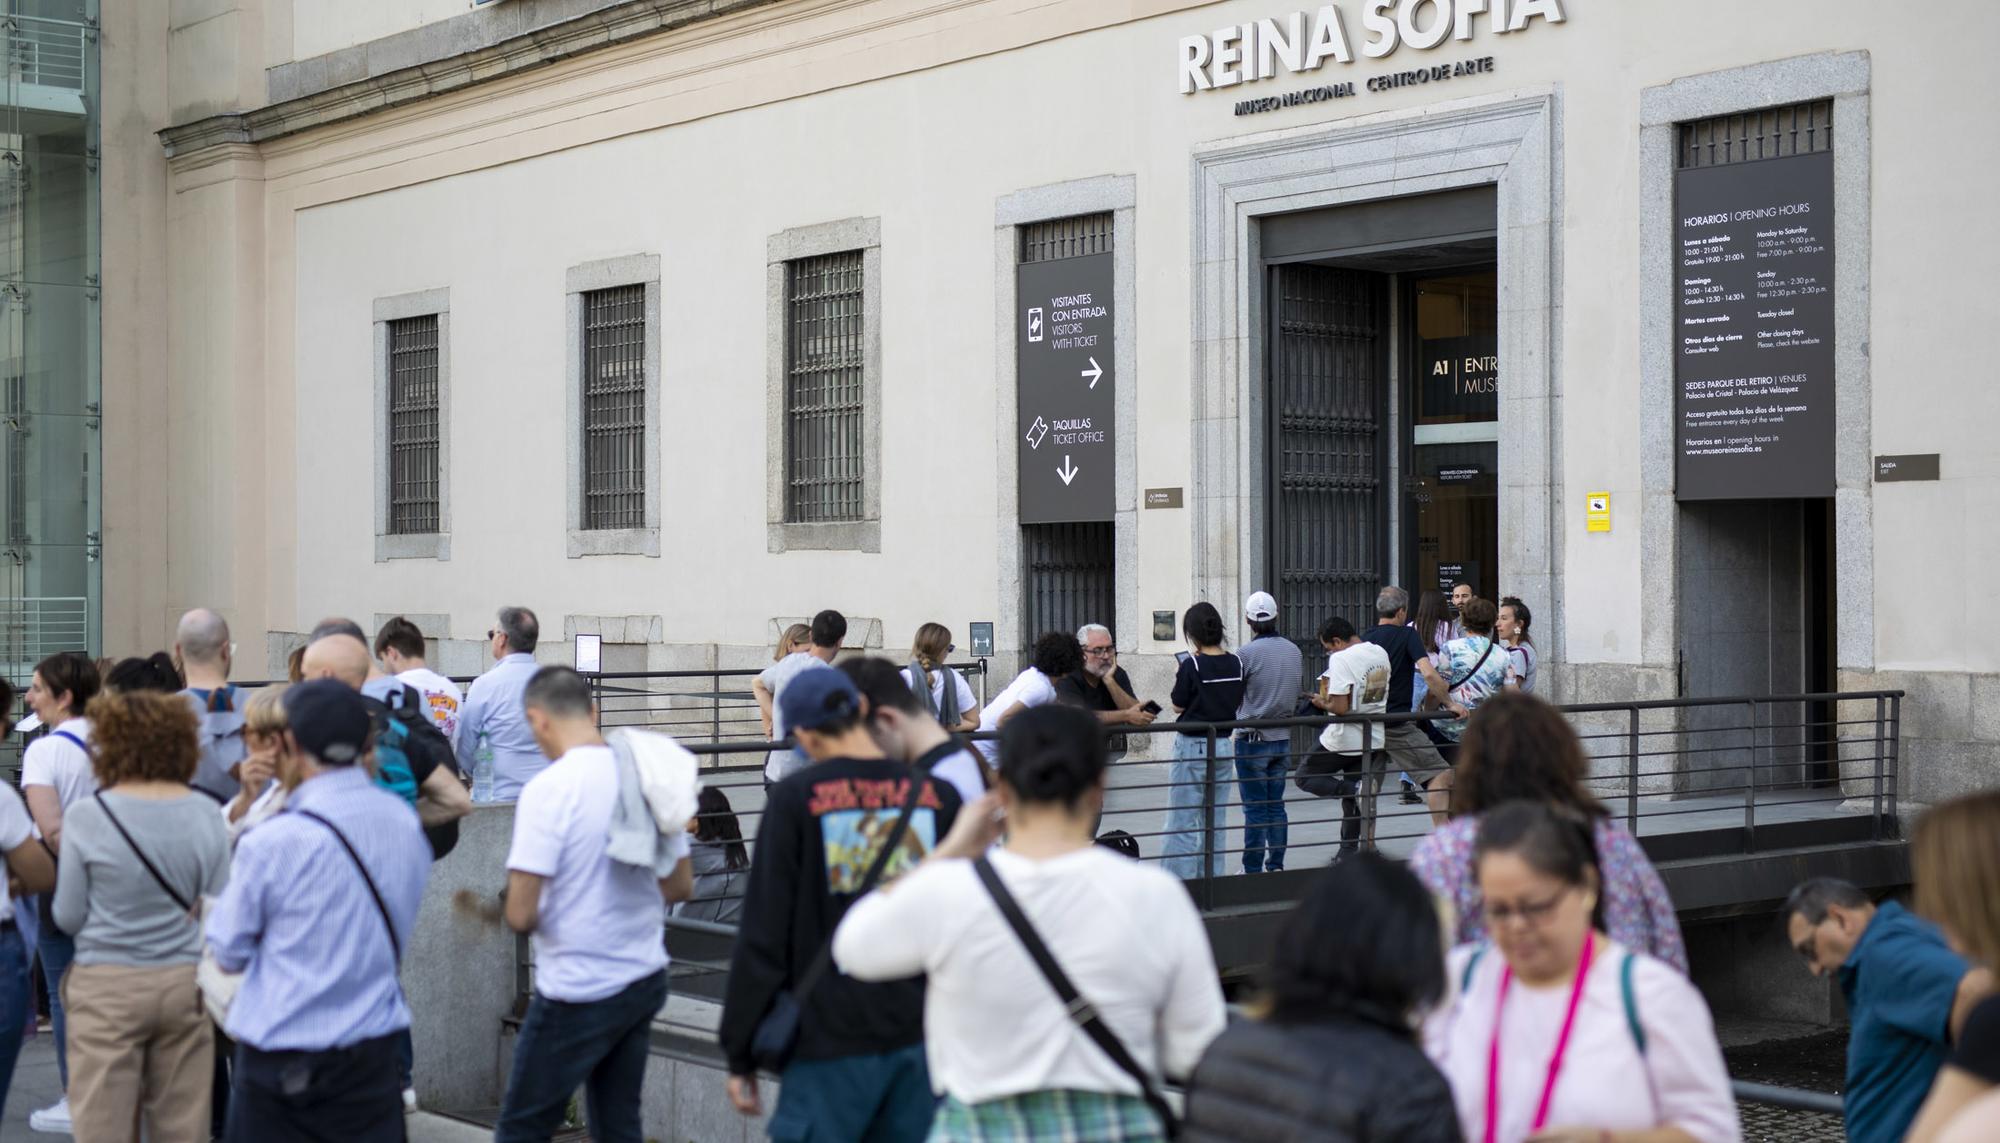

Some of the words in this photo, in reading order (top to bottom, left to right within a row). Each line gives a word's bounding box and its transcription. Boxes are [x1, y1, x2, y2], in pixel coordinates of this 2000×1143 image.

[1179, 4, 1355, 95] REINA
[1234, 97, 1282, 117] MUSEO
[1281, 82, 1356, 108] NACIONAL
[1366, 68, 1430, 92] CENTRO
[1430, 63, 1451, 81] DE
[1452, 56, 1495, 77] ARTE
[1684, 213, 1728, 227] HORARIOS
[1734, 207, 1777, 221] OPENING
[1779, 202, 1810, 216] HOURS
[1757, 229, 1778, 238] Monday
[1785, 225, 1808, 234] Saturday
[1708, 235, 1731, 244] sábado
[1756, 269, 1776, 279] Sunday
[1684, 277, 1711, 286] Domingo
[1051, 293, 1092, 308] VISITANTES
[1052, 310, 1070, 322] CON
[1071, 306, 1107, 320] ENTRADA
[1684, 317, 1706, 325] Martes
[1706, 314, 1730, 323] cerrado
[1756, 309, 1777, 318] Tuesday
[1777, 307, 1795, 317] closed
[1052, 322, 1083, 336] VISITORS
[1756, 331, 1772, 339] Other
[1772, 329, 1791, 338] closing
[1791, 328, 1804, 336] days
[1052, 338, 1072, 349] WITH
[1073, 335, 1098, 347] TICKET
[1716, 334, 1725, 342] de
[1725, 333, 1743, 341] cierre
[1684, 346, 1707, 354] Consultar
[1708, 345, 1720, 353] web
[1432, 359, 1449, 376] A1
[1685, 380, 1706, 390] SEDES
[1707, 379, 1735, 389] PARQUE
[1735, 378, 1748, 387] DEL
[1749, 376, 1773, 386] RETIRO
[1779, 373, 1807, 383] VENUES
[1685, 391, 1706, 400] Palacio
[1706, 389, 1714, 398] de
[1714, 388, 1734, 398] Cristal
[1738, 387, 1759, 396] Palacio
[1760, 386, 1768, 395] de
[1706, 408, 1728, 419] gratuito
[1728, 407, 1744, 415] todos
[1745, 406, 1754, 414] los
[1768, 405, 1776, 413] de
[1777, 404, 1783, 412] la
[1052, 417, 1091, 431] TAQUILLAS
[1685, 420, 1698, 428] Free
[1723, 419, 1739, 427] every
[1739, 417, 1751, 426] day
[1751, 416, 1758, 424] of
[1758, 415, 1768, 423] the
[1768, 414, 1784, 422] week
[1052, 432, 1077, 445] TICKET
[1078, 431, 1104, 443] OFFICE
[1685, 437, 1713, 446] Horarios
[1727, 436, 1753, 445] opening
[1754, 434, 1771, 443] hours
[1772, 434, 1779, 442] in
